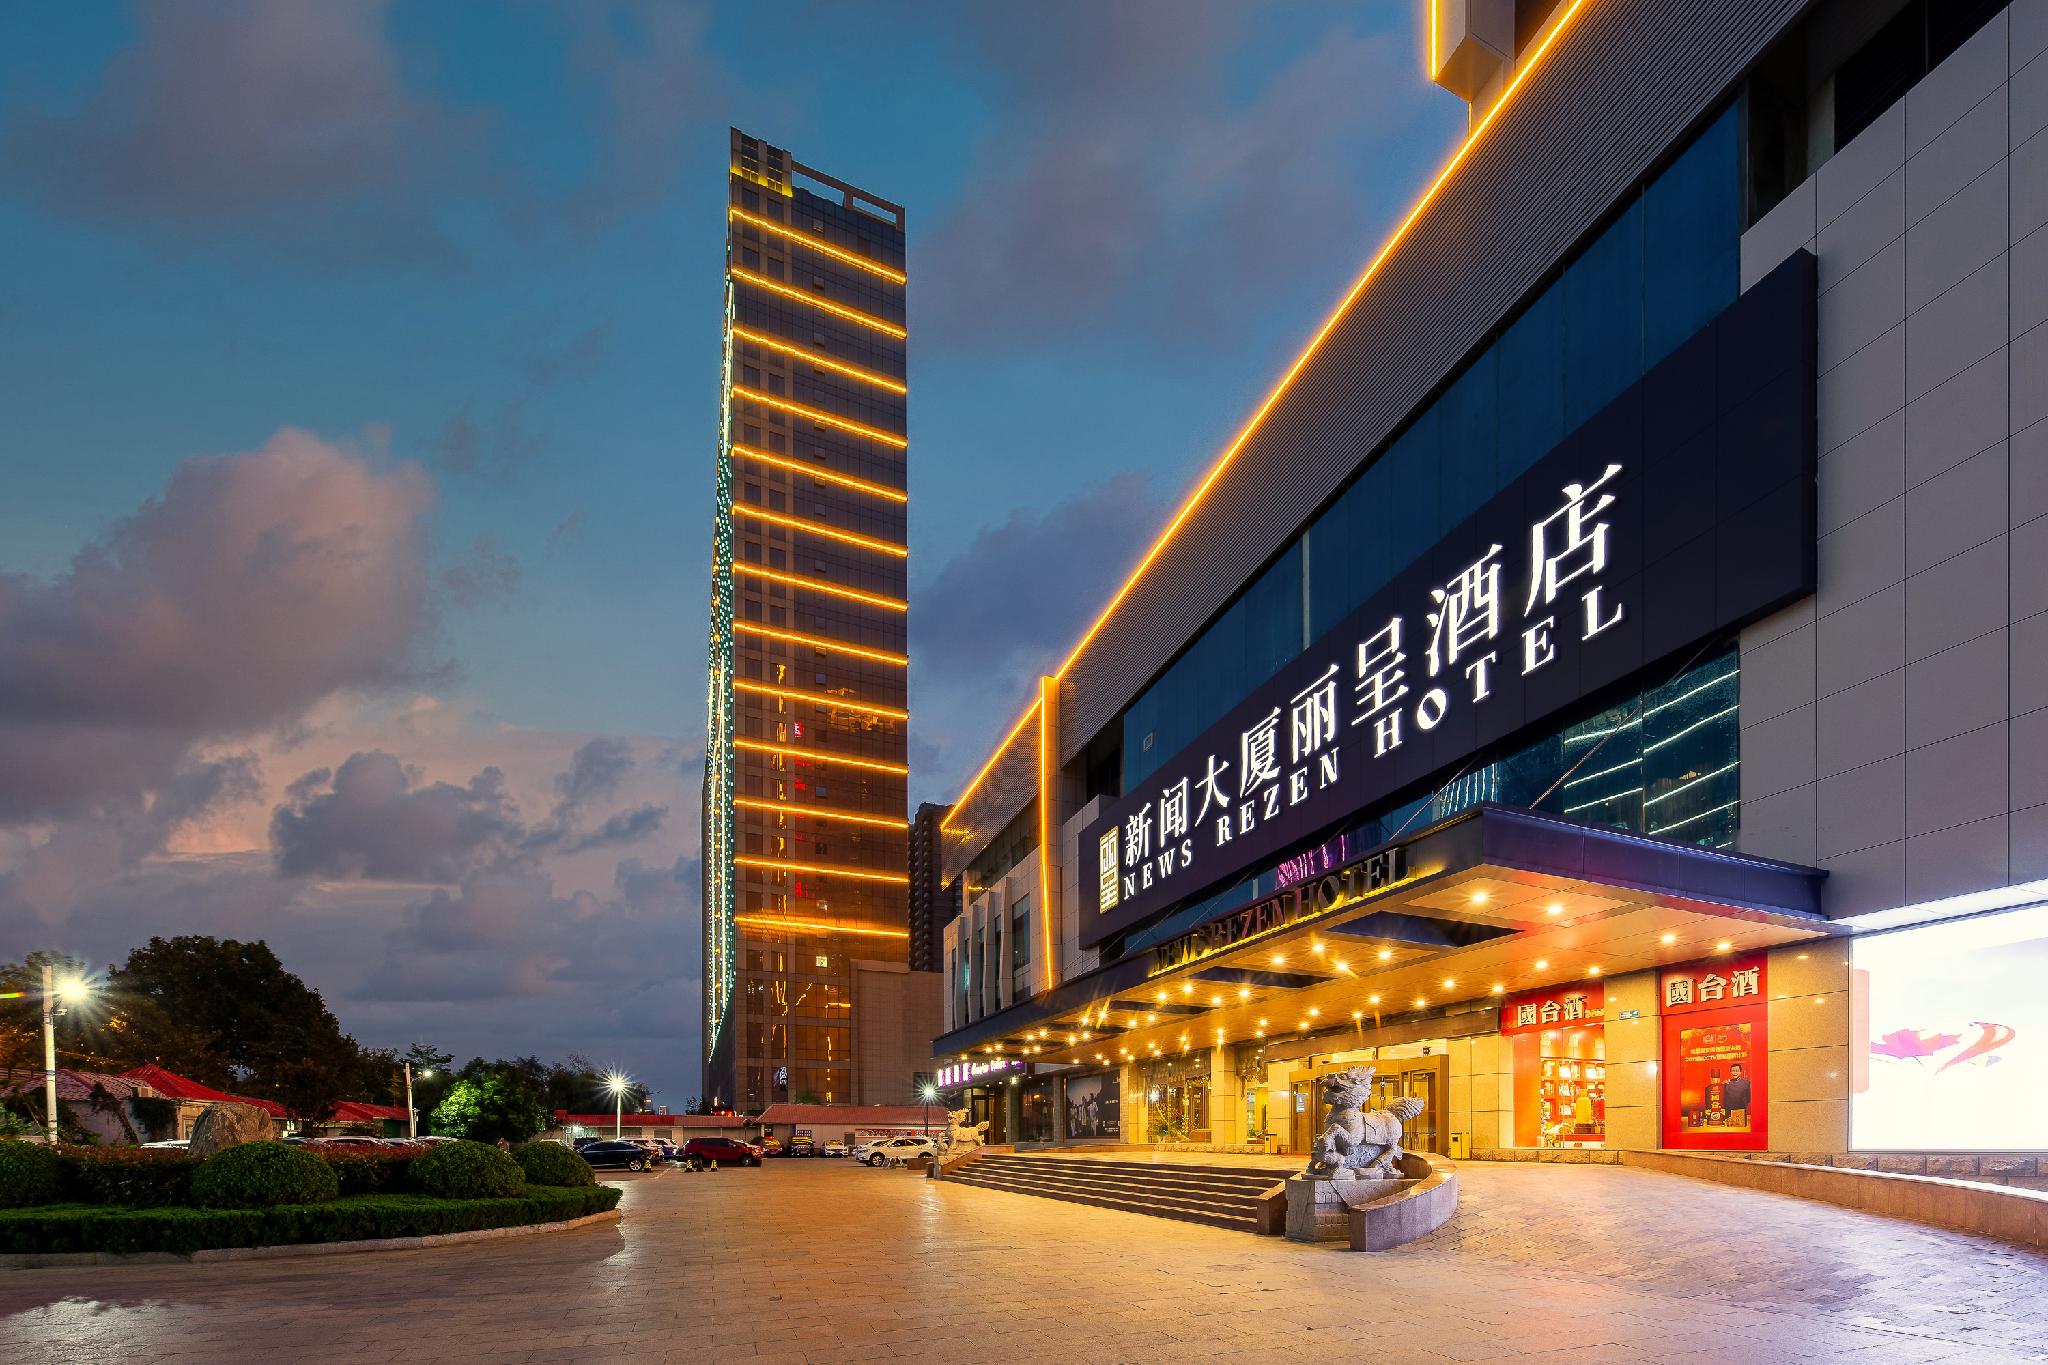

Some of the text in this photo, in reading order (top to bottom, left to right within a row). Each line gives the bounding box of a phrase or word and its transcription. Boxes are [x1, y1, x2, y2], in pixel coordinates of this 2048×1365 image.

[1124, 463, 1623, 868] 新闻大厦丽呈酒店
[1123, 838, 1193, 902] NEWS
[1216, 746, 1341, 848] REZEN
[1373, 585, 1623, 760] HOTEL
[1210, 892, 1293, 949] REZEN
[1293, 847, 1411, 923] HOTEL
[1517, 993, 1586, 1028] 國台酒
[1666, 966, 1760, 1008] 國台酒
